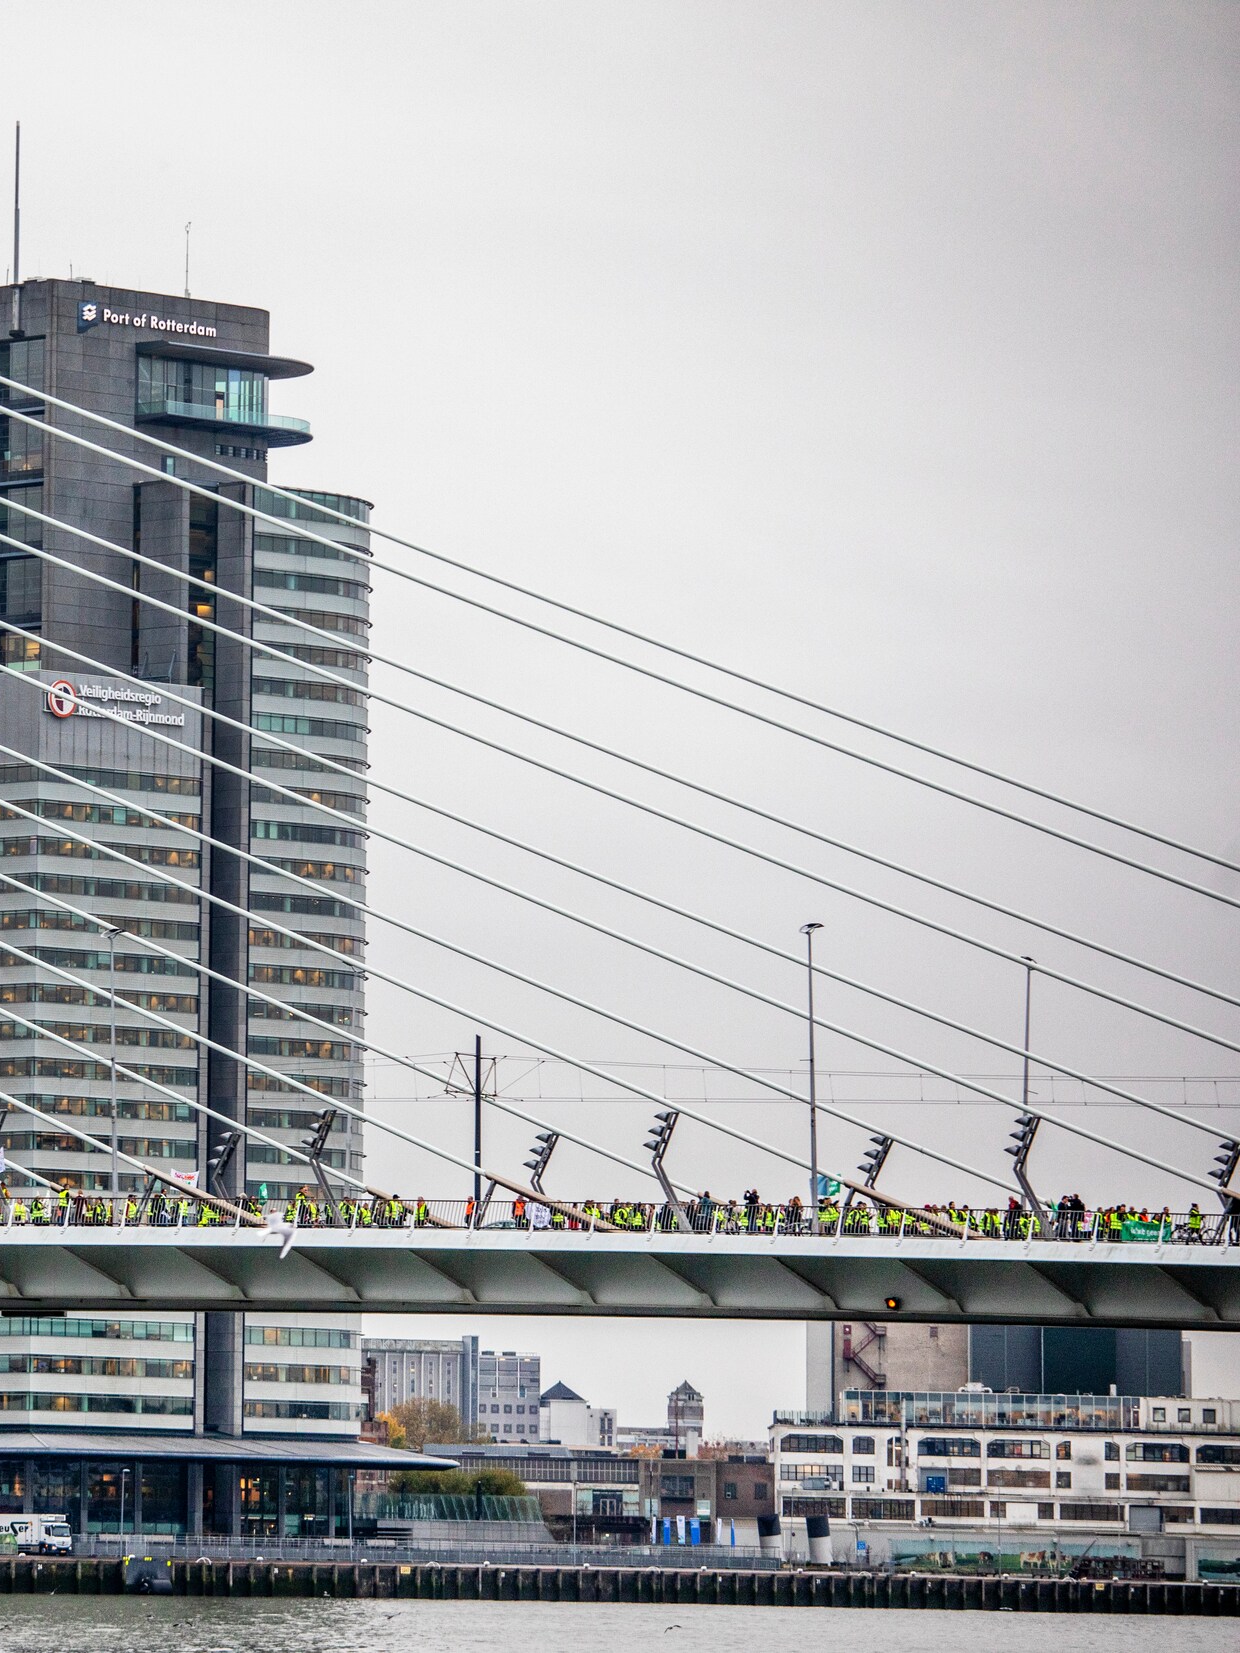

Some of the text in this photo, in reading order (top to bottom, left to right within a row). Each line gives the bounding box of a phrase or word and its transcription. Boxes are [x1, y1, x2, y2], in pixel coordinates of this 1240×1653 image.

[103, 308, 217, 338] Port of Rotterdam
[79, 684, 162, 706] Veiligheidsregio
